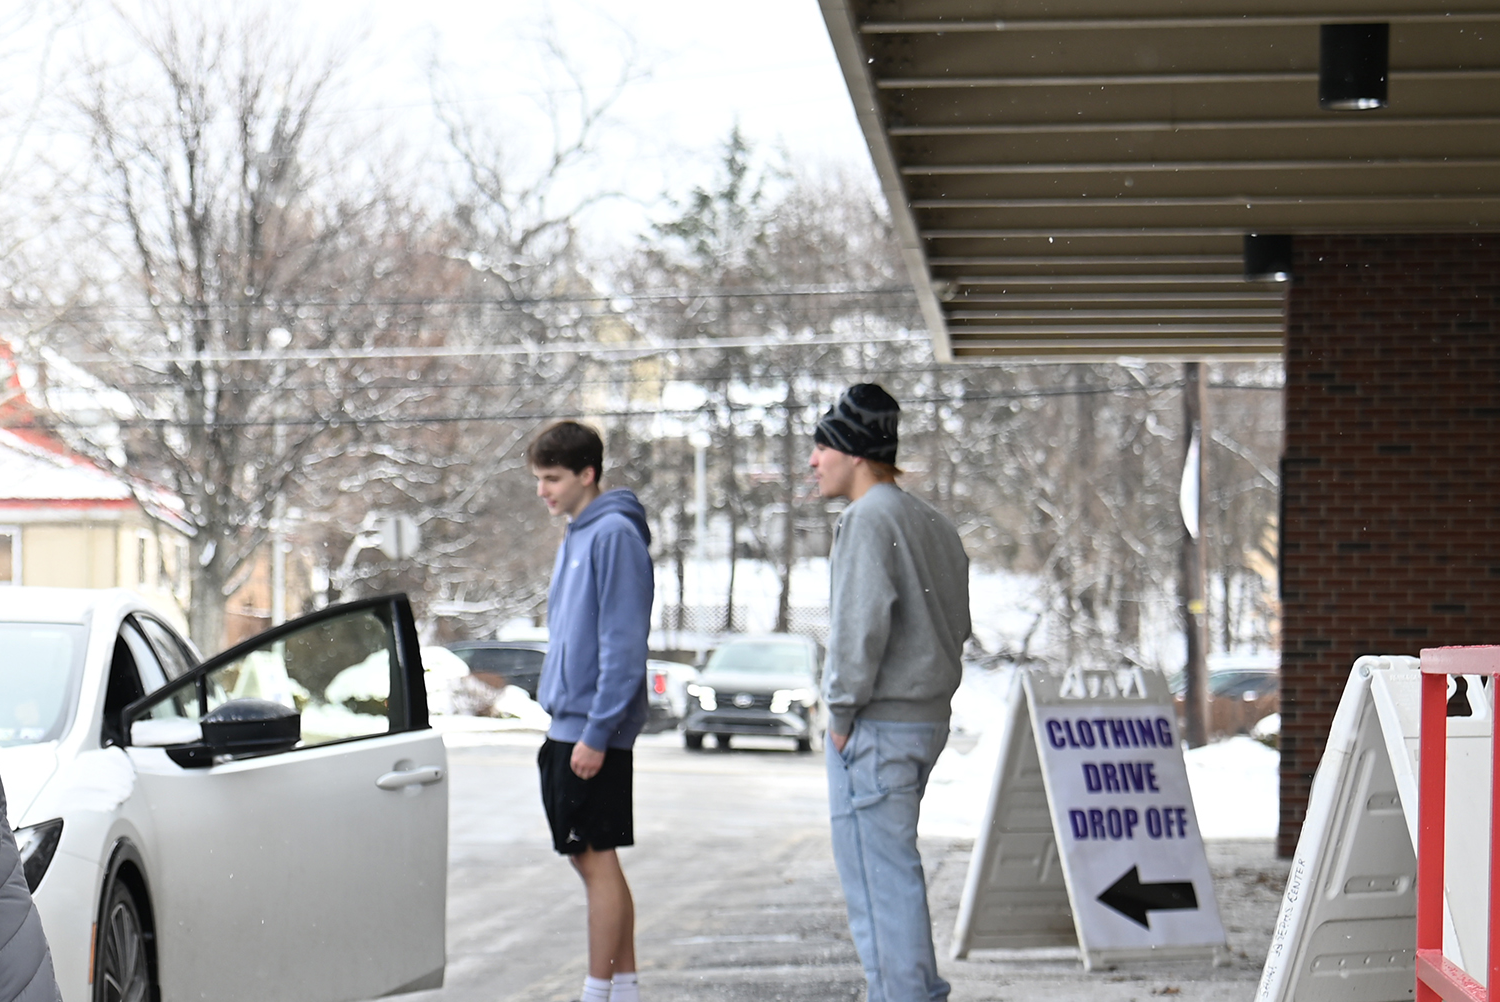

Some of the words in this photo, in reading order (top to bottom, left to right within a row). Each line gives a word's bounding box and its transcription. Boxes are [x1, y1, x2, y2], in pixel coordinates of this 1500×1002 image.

[1046, 718, 1173, 750] CLOTHING
[1082, 763, 1160, 793] DRIVE
[1068, 808, 1139, 841] DROP
[1145, 806, 1188, 839] OFF
